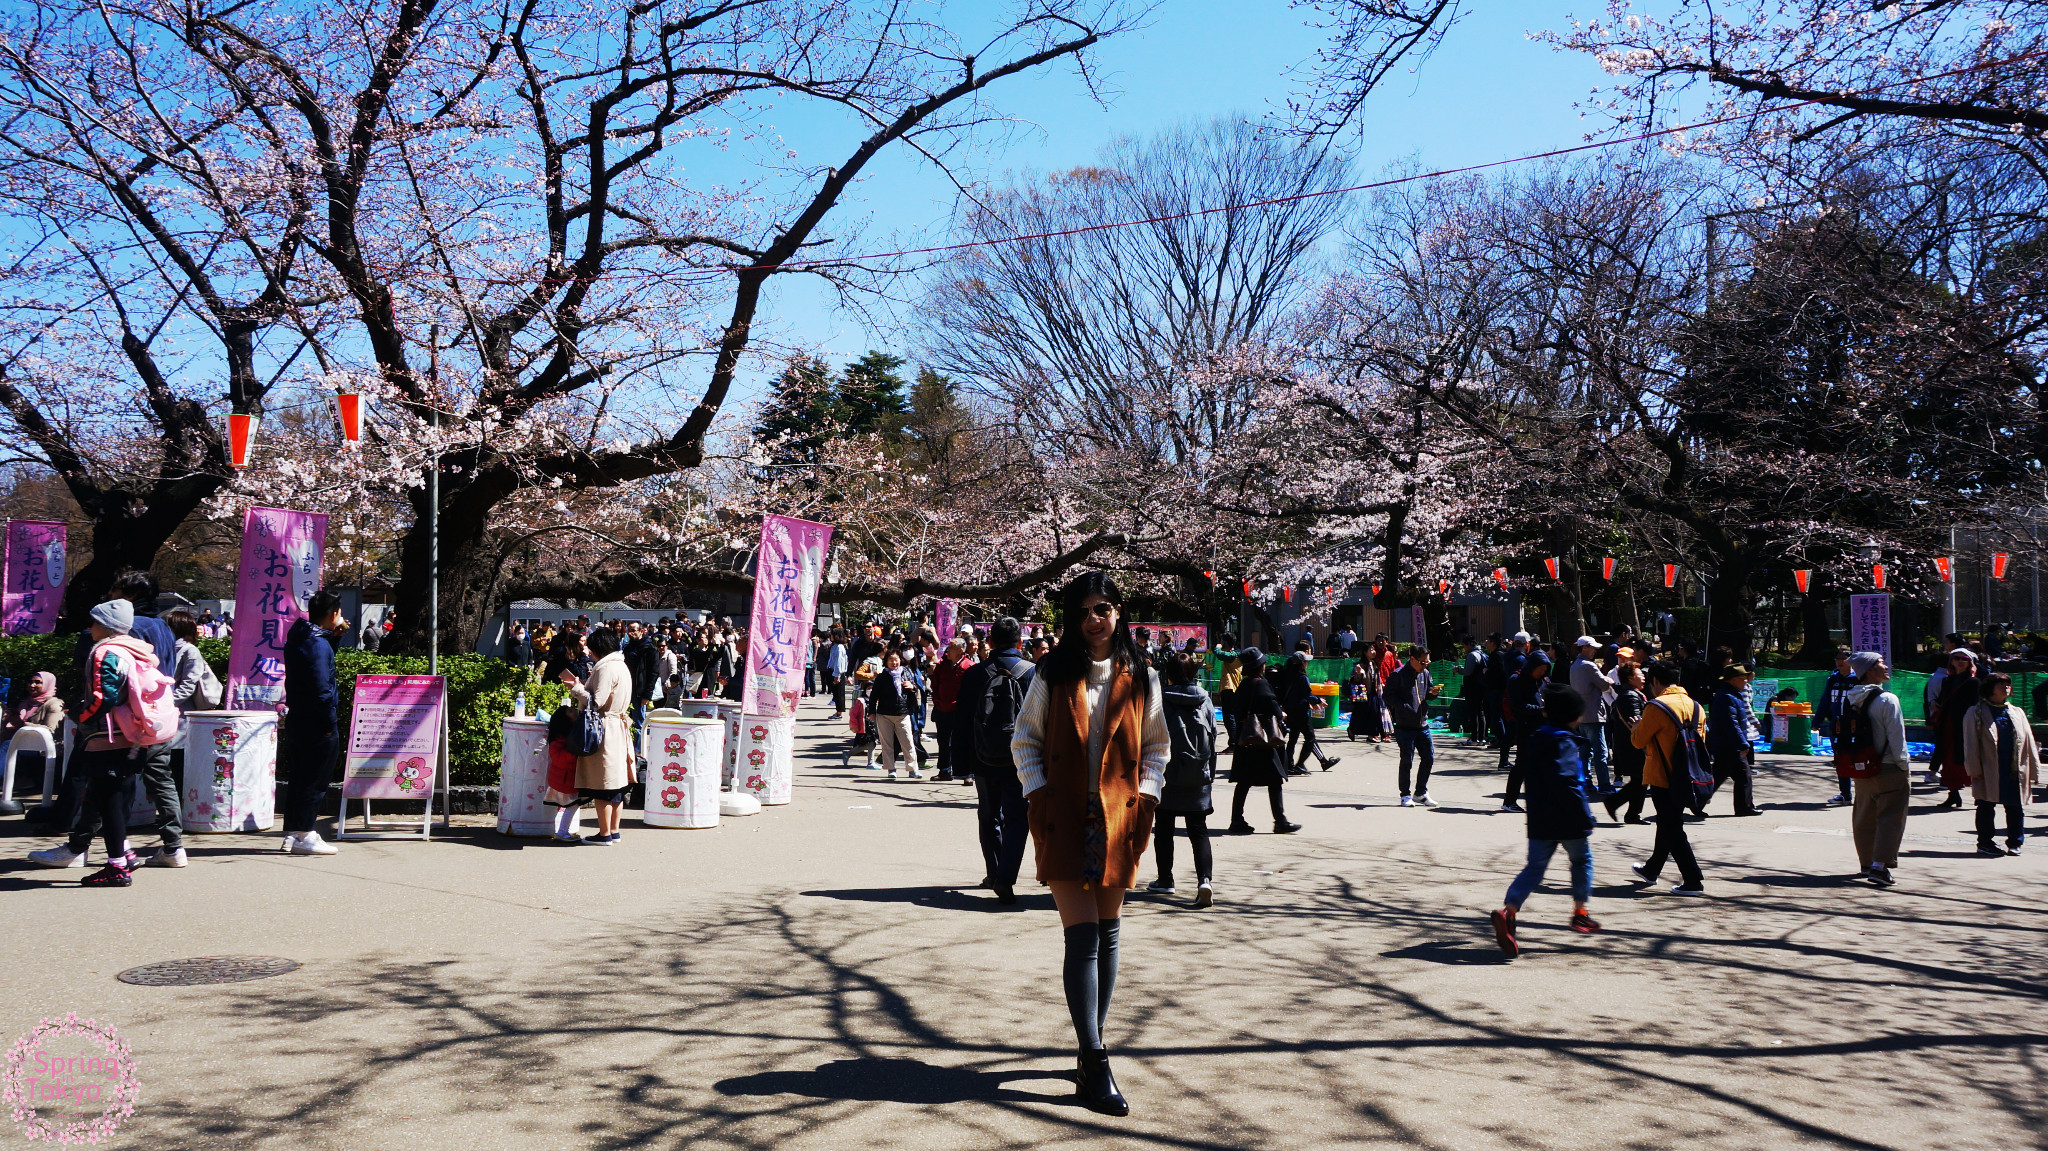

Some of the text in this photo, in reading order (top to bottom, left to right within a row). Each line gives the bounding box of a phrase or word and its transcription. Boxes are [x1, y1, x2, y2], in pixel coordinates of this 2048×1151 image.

[14, 547, 44, 634] お花見処
[52, 547, 61, 580] ふらっと
[301, 551, 315, 601] ふらっと
[249, 549, 290, 682] お花見処
[760, 554, 799, 675] お花見処
[1860, 598, 1871, 651] 終了してください
